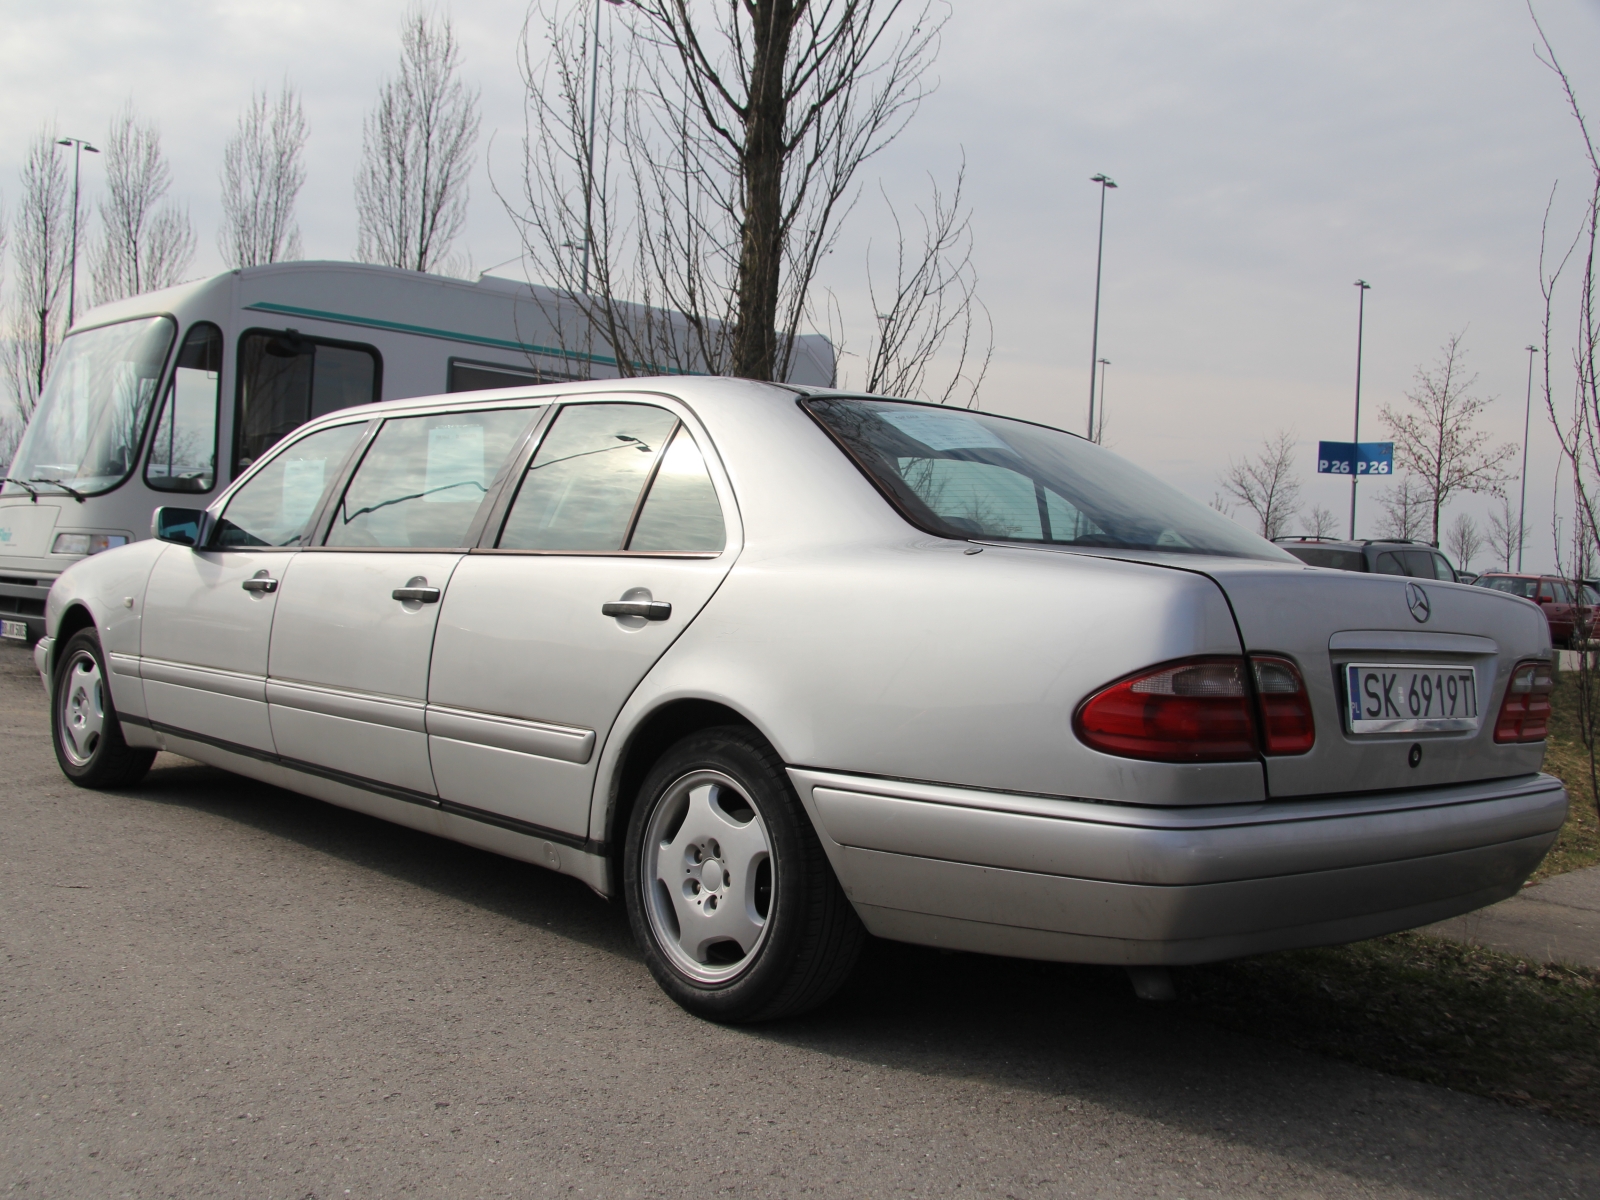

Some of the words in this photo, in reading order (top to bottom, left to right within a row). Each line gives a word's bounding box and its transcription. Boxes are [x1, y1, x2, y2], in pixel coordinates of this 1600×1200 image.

[1319, 460, 1329, 472] P
[1331, 461, 1350, 474] 26
[1357, 461, 1367, 474] P
[1369, 461, 1389, 474] 26
[1364, 673, 1401, 718] SK
[1408, 673, 1470, 717] 6919T
[1351, 702, 1360, 714] PL
